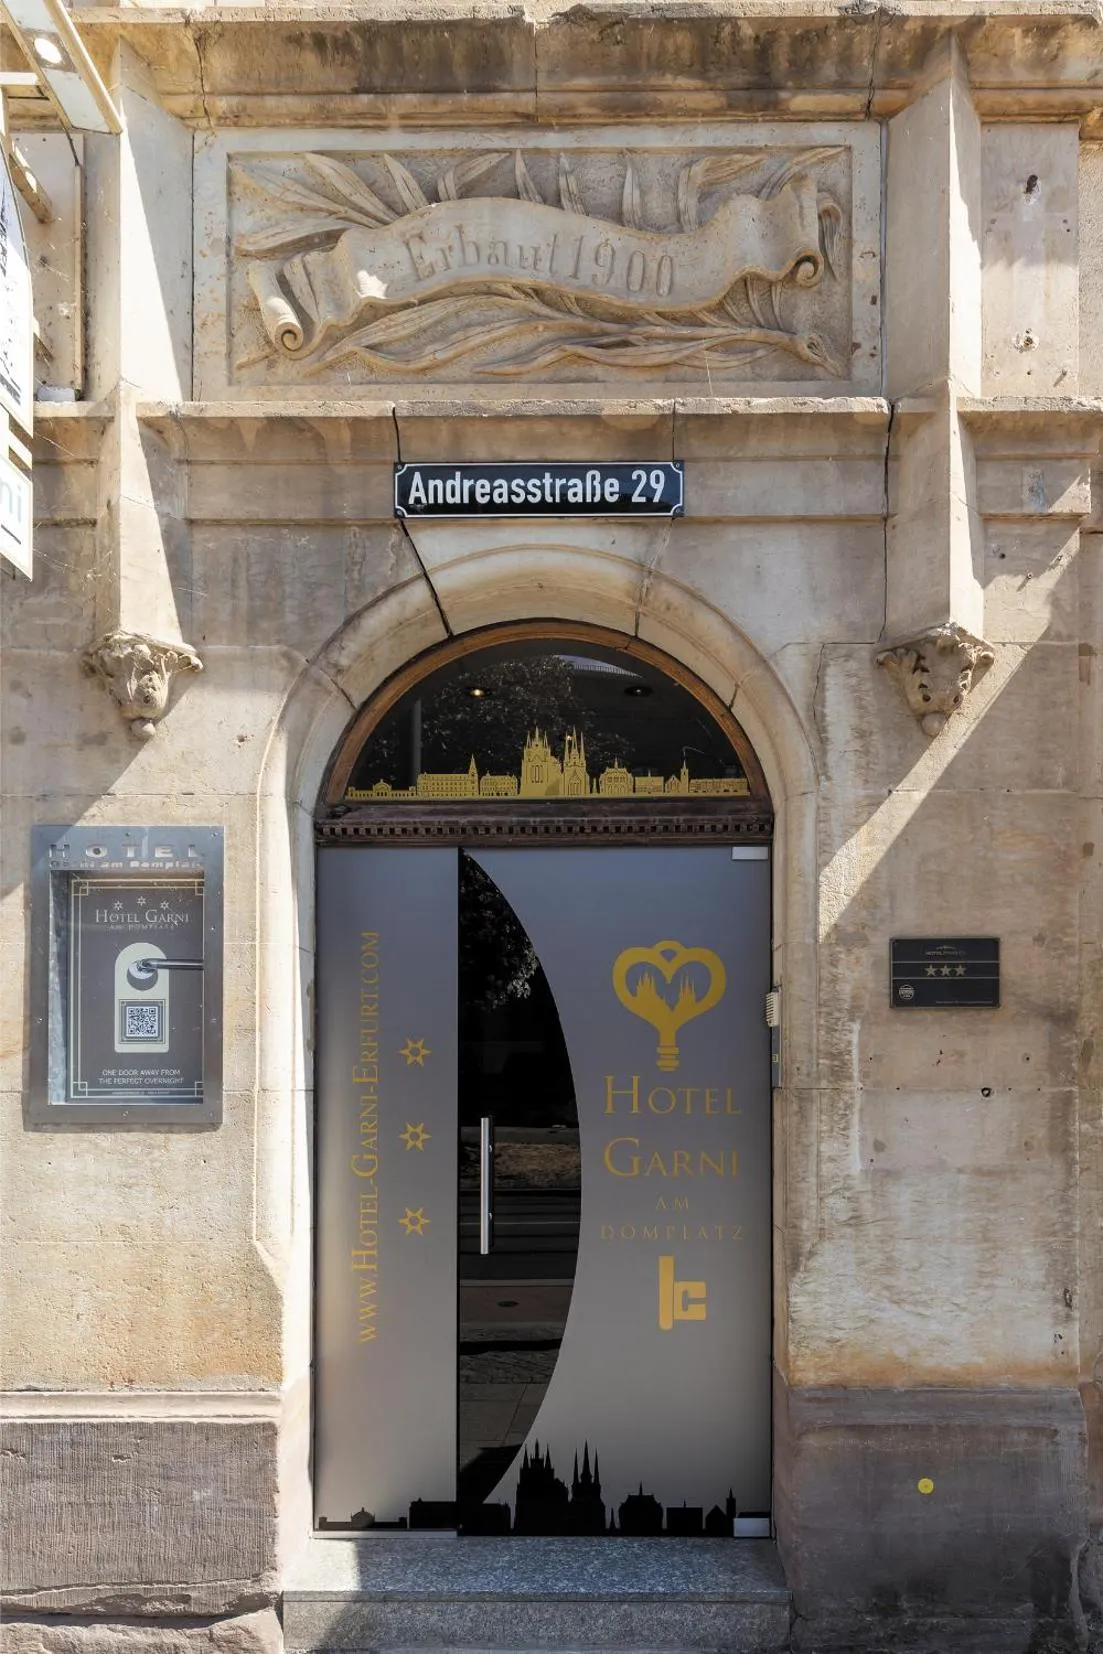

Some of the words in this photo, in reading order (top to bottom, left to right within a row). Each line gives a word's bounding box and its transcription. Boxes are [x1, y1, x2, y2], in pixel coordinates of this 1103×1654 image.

[403, 223, 558, 282] Erbaut
[569, 235, 674, 297] 1900
[408, 470, 620, 504] Andreasstraße
[631, 470, 665, 503] 29
[655, 1195, 689, 1210] AM
[600, 1224, 745, 1241] DOMPLATZ
